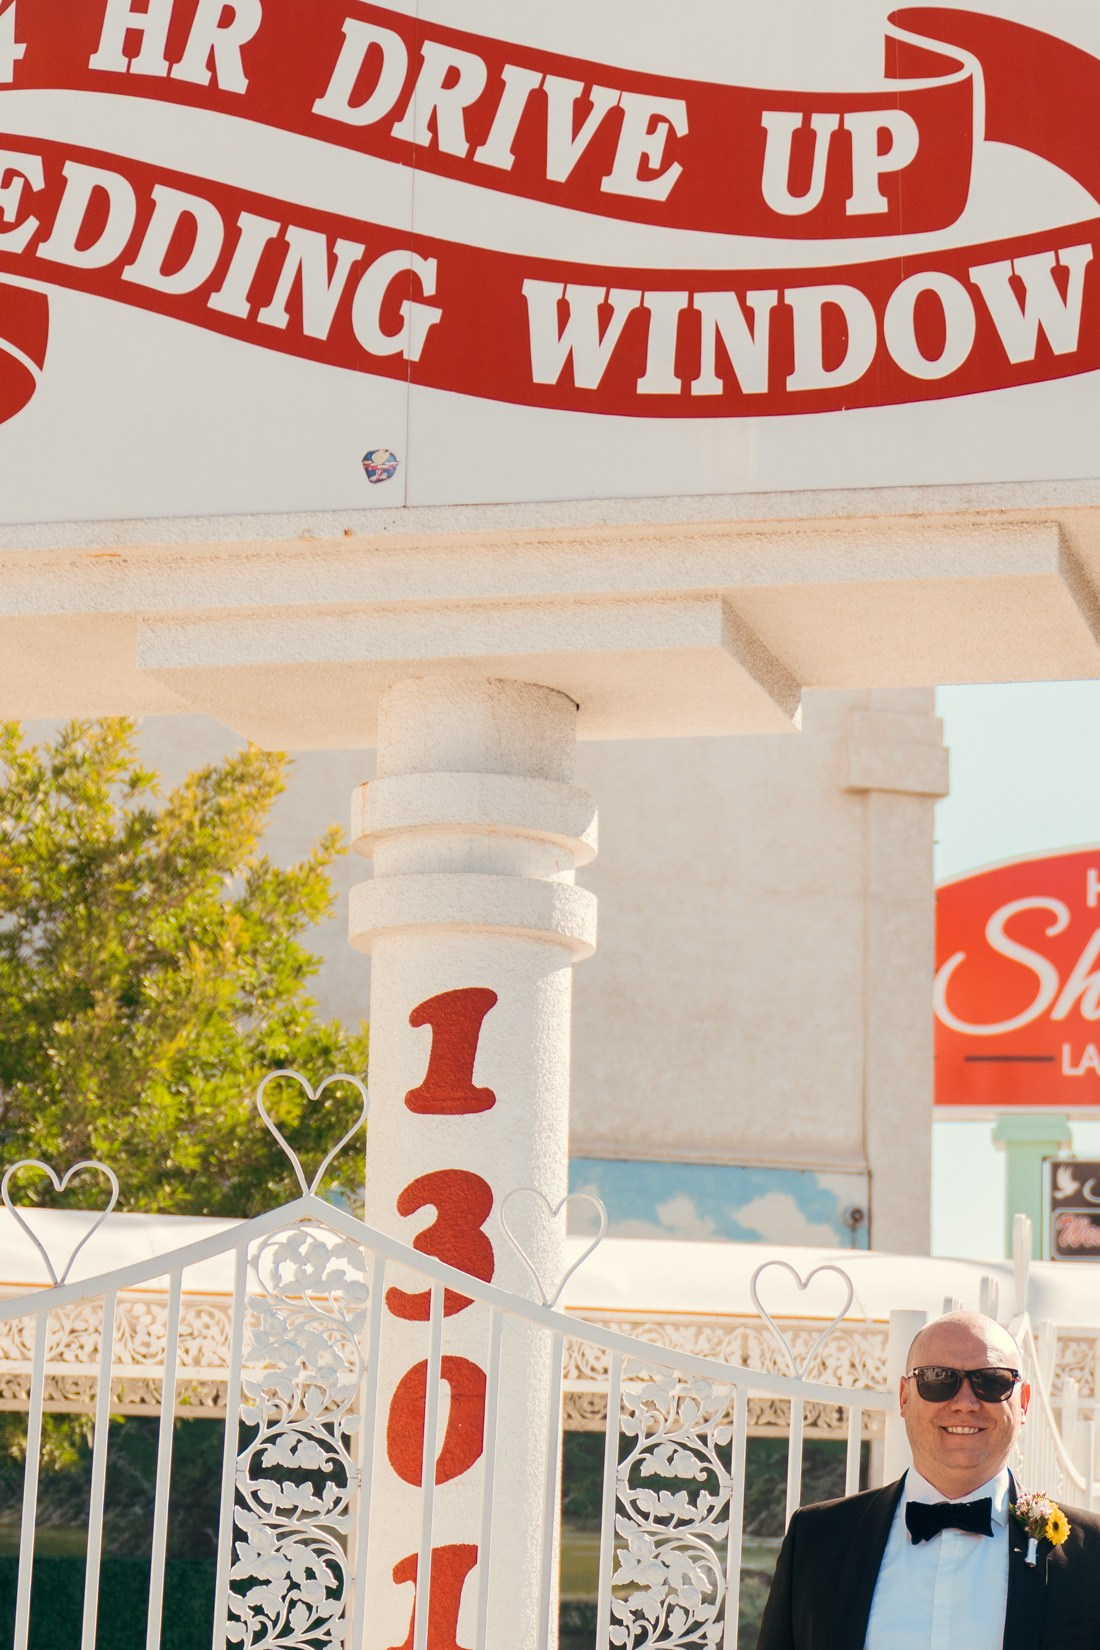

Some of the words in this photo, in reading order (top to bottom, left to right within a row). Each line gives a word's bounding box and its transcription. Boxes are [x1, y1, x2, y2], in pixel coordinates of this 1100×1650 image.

[88, 0, 262, 95] HR
[311, 17, 689, 202] DRIVE
[761, 109, 920, 216] UP
[0, 149, 442, 362] EDDING
[522, 243, 1093, 395] WINDOW
